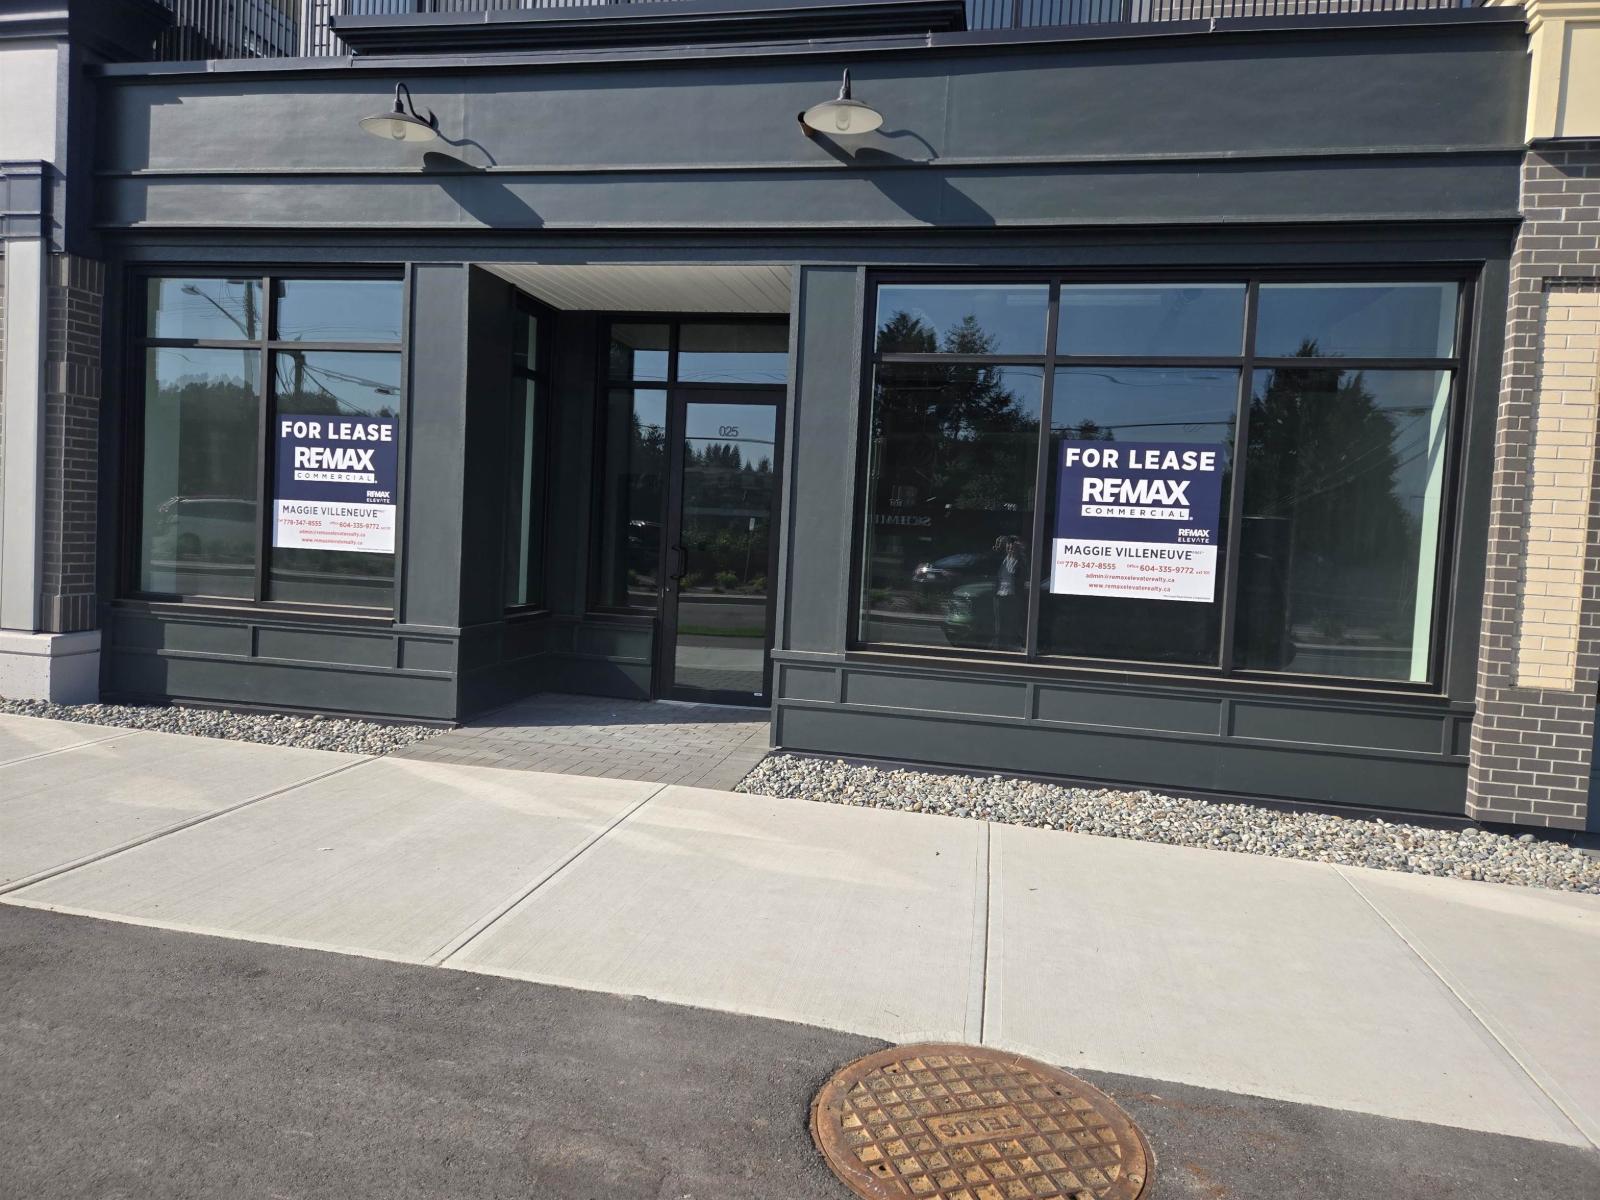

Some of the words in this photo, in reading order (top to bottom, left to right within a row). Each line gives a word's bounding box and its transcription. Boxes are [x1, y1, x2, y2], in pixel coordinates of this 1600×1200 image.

[281, 421, 321, 439] FOR
[328, 422, 392, 441] LEASE
[719, 425, 739, 437] 025
[1066, 448, 1119, 468] FOR
[1128, 449, 1216, 471] LEASE
[297, 472, 372, 482] COMMERCIAL
[282, 505, 318, 515] MAGGIE
[321, 507, 378, 518] VILLENEUVE
[1085, 507, 1185, 518] COMMERCIAL
[1064, 545, 1112, 557] MAGGIE
[1116, 547, 1192, 560] VILLENEUVE
[1064, 560, 1116, 570] 778-347-8555
[1139, 564, 1194, 575] 604-335-9772
[938, 1114, 1021, 1138] TELUS
